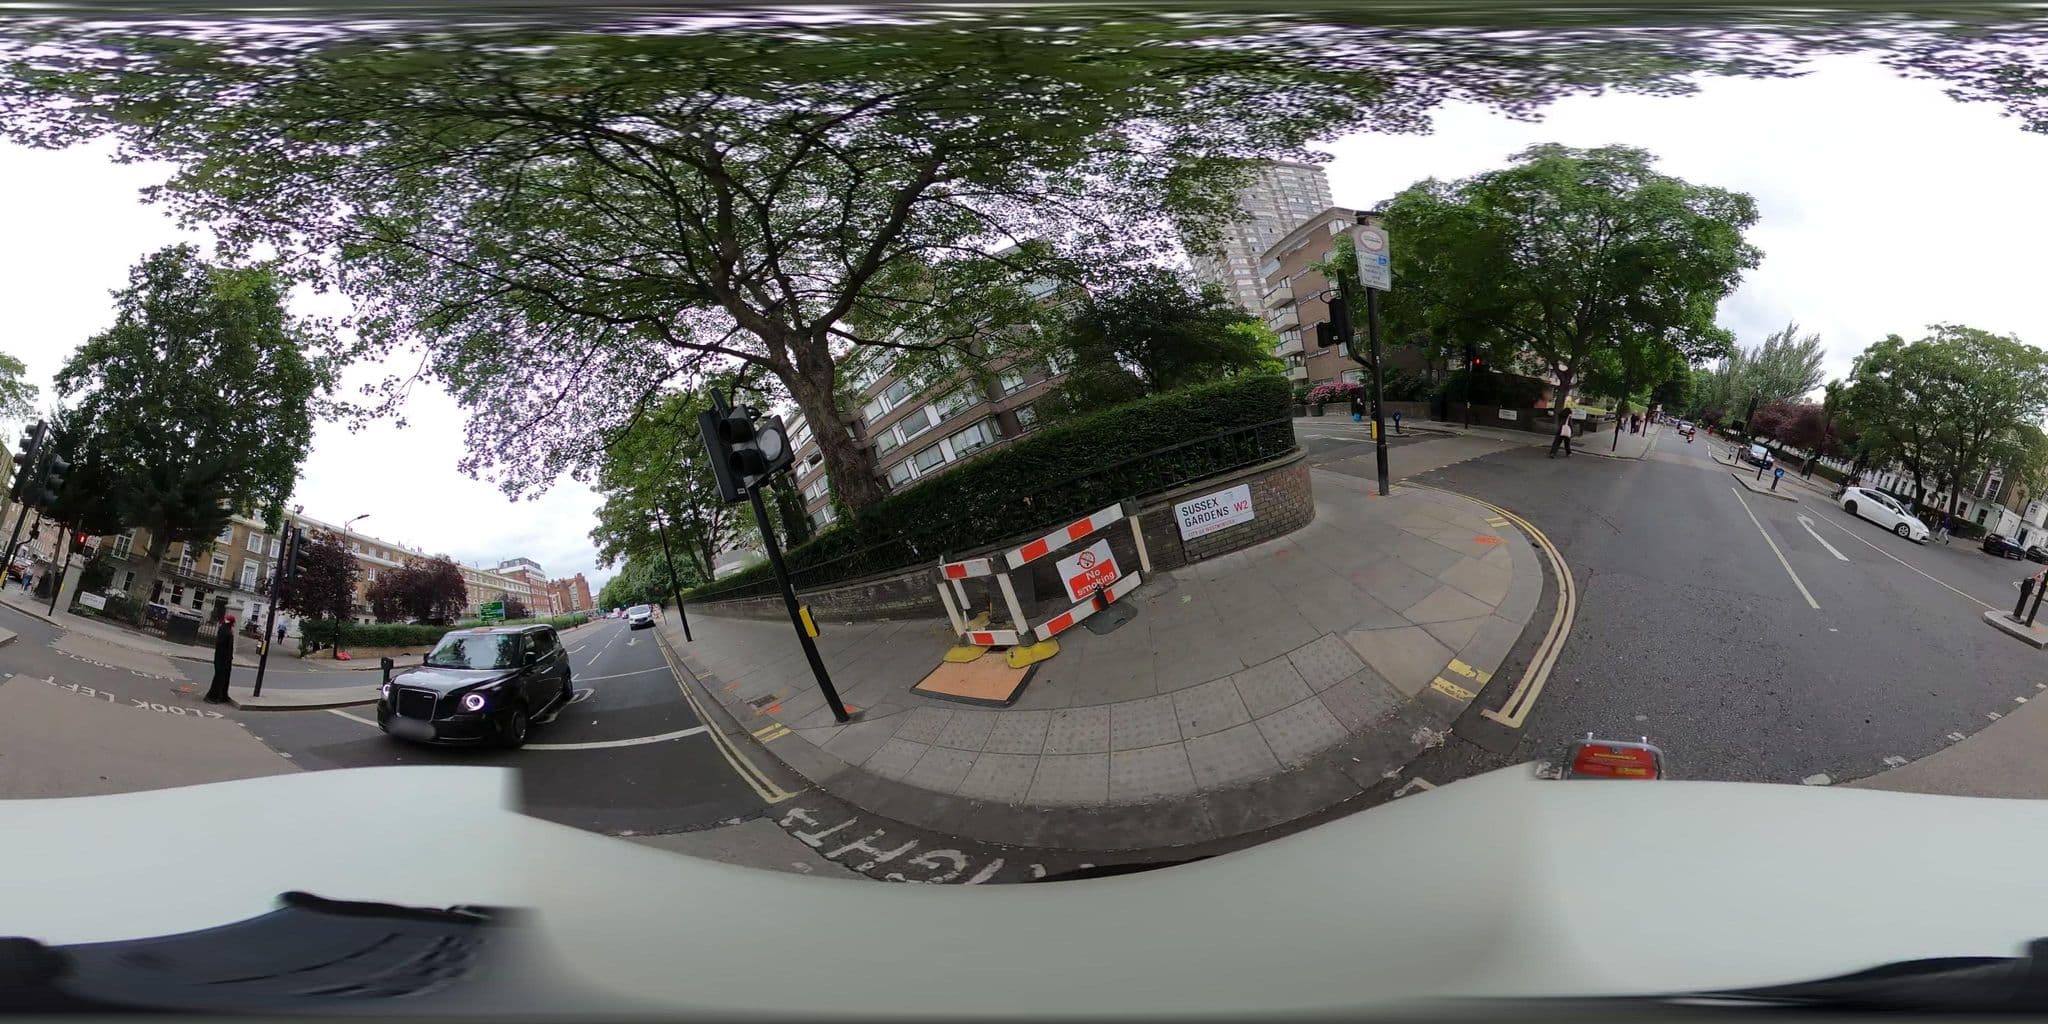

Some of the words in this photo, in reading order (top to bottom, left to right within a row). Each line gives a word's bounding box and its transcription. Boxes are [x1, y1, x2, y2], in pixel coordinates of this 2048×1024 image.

[1182, 497, 1219, 517] SUSSEX
[1234, 500, 1249, 512] W2
[1185, 506, 1230, 528] GARDENS
[1077, 571, 1115, 596] smoking
[1085, 569, 1101, 581] No
[40, 675, 116, 703] LEFT
[130, 698, 206, 718] LOOK
